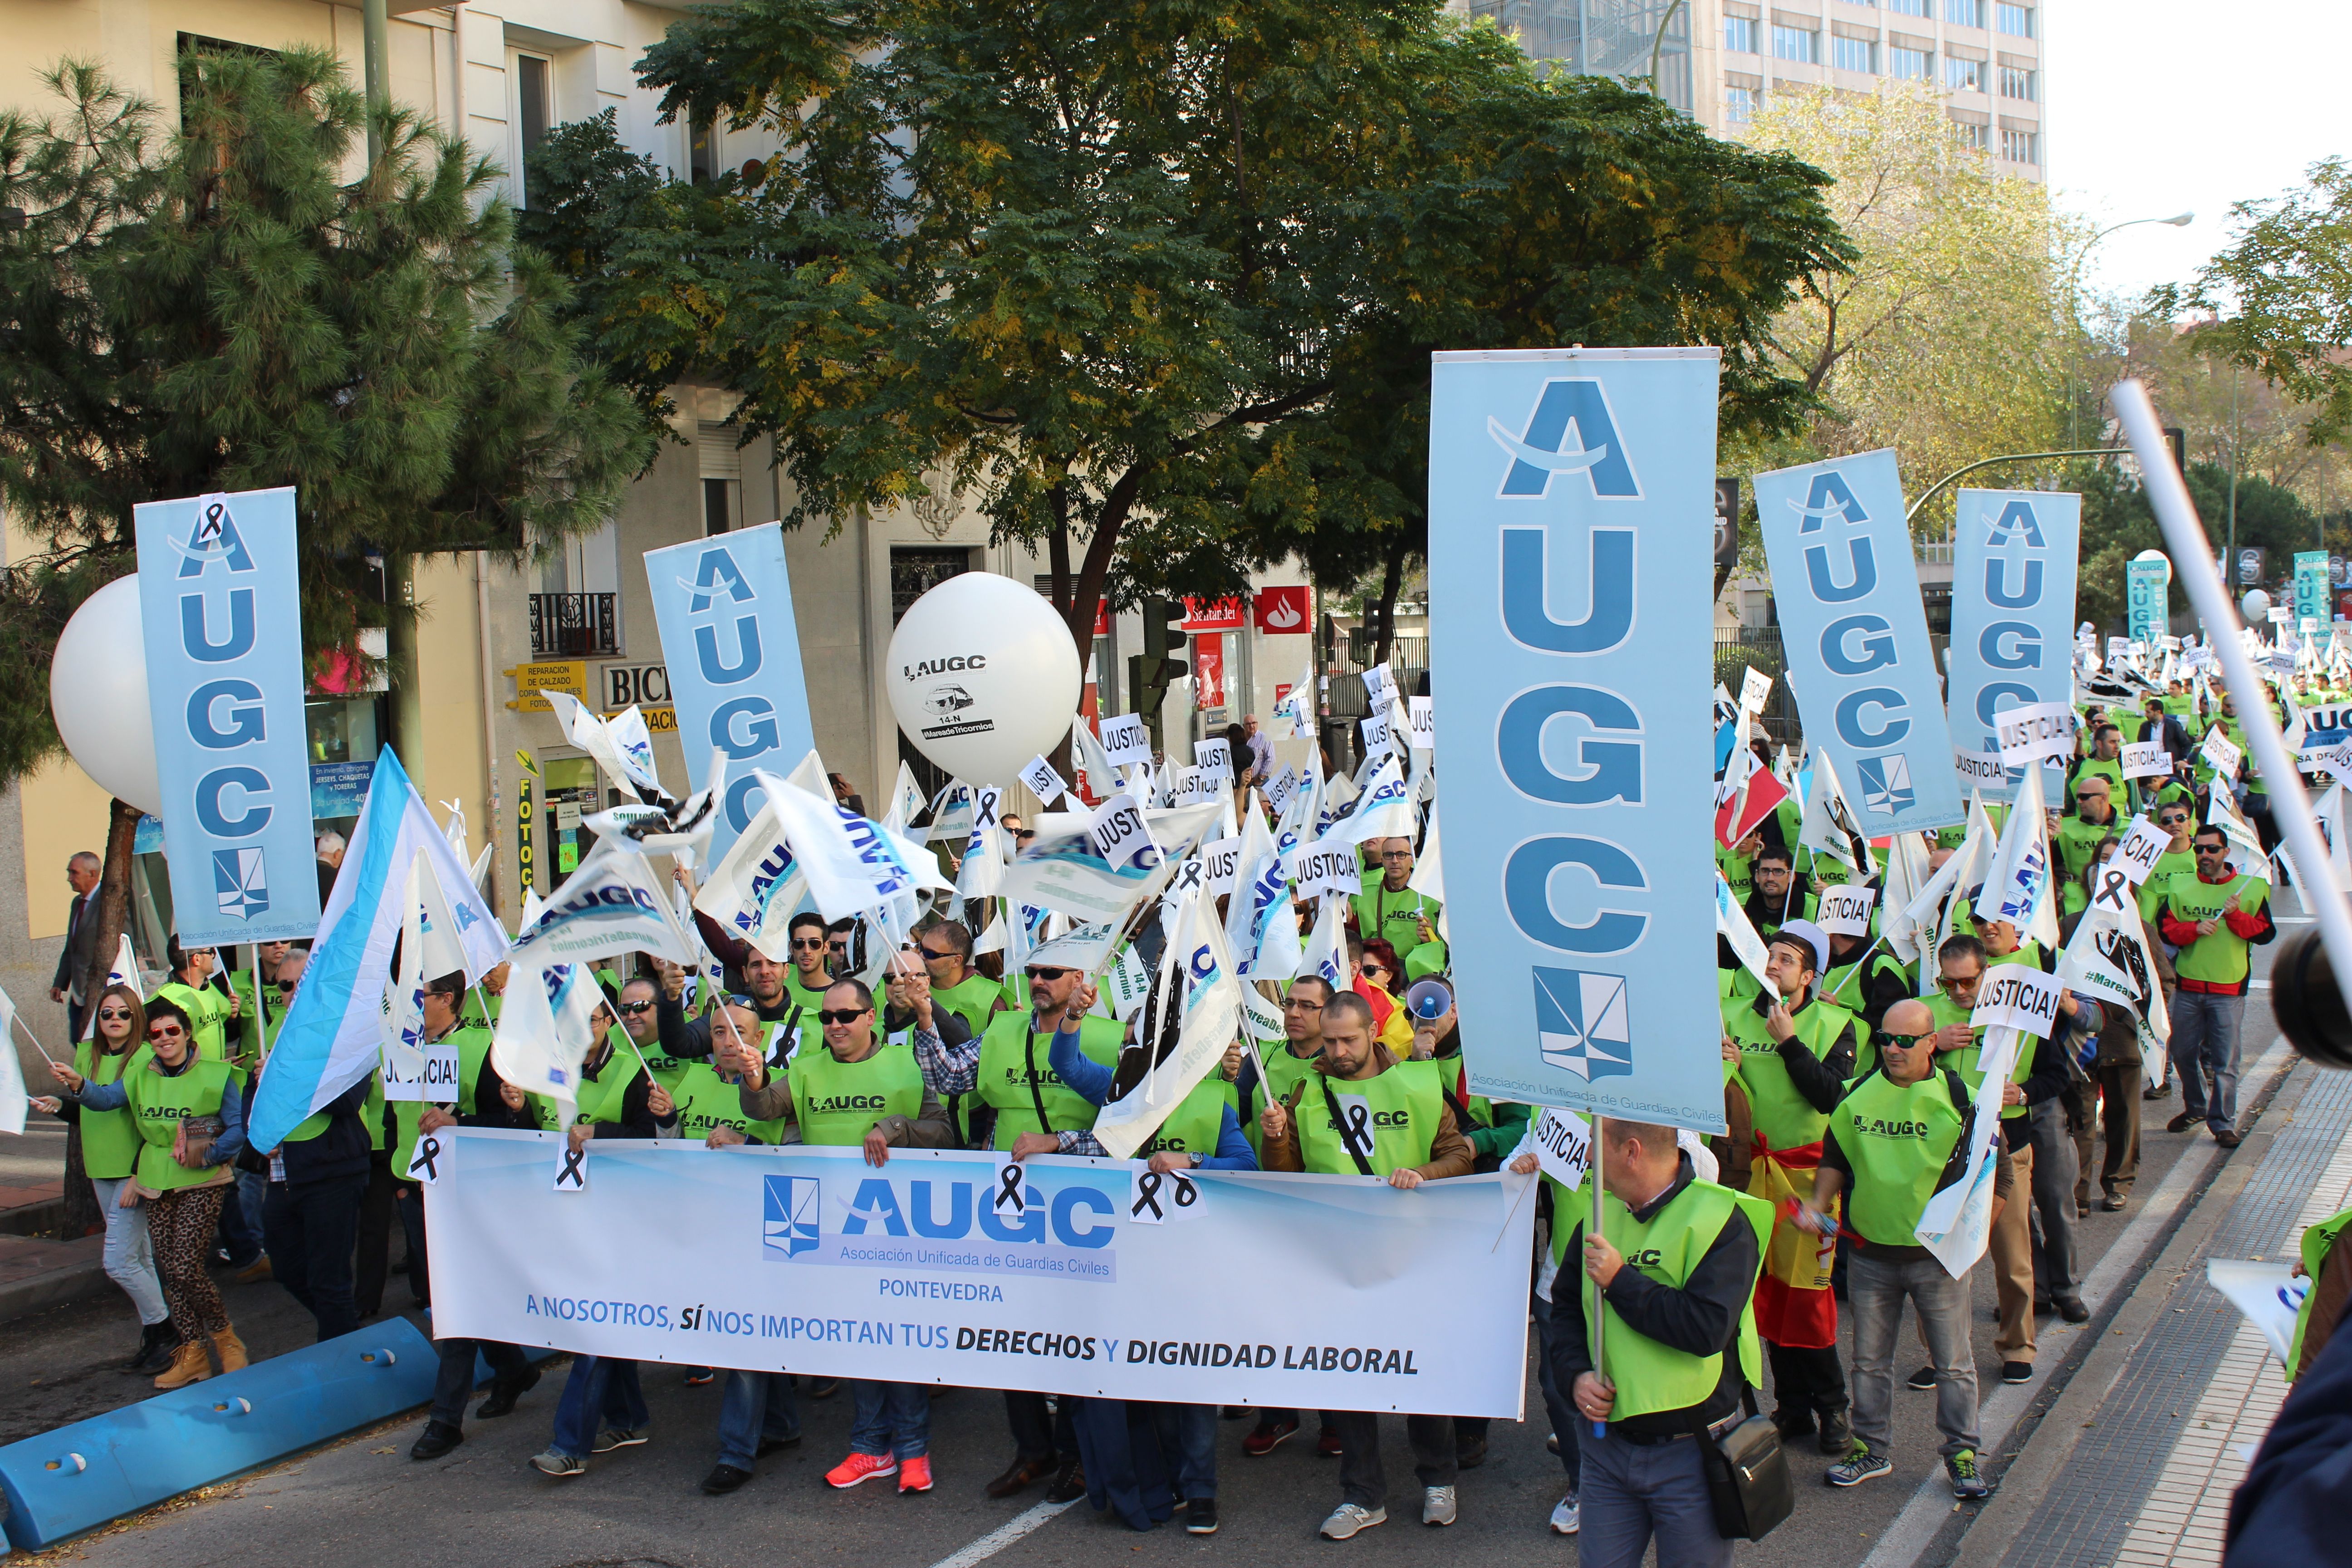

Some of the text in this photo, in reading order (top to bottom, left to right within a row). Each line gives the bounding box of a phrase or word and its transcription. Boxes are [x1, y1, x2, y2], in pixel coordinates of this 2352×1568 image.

[1787, 470, 1912, 750] AUGC
[1976, 500, 2048, 731] AUGC
[167, 507, 274, 839] AUGC
[528, 666, 570, 676] REPARACION
[915, 654, 987, 677] AUGC
[1488, 377, 1651, 957] AUGC
[519, 688, 541, 697] COPIAS
[539, 676, 571, 686] CALZADO
[923, 722, 994, 739] #MareadeTricornios
[939, 715, 961, 724] 14-N
[2001, 715, 2073, 750] JUSTICIA!
[2122, 750, 2159, 770] JUSTICIA!
[2206, 733, 2239, 769] JUSTICIA!
[338, 773, 370, 781] CHAQUETAS
[346, 765, 369, 773] abrigate
[1955, 753, 2005, 779] JUSTICIA!
[334, 783, 357, 791] TORERAS
[1269, 767, 1297, 806] JUSTICIA!
[326, 796, 350, 806] unidad
[1869, 820, 1899, 833] Unificada
[1911, 815, 1942, 826] Guardias
[1942, 812, 1965, 822] Civiles
[752, 843, 794, 906] AU
[1297, 853, 1359, 884] JUSTICIA!
[1816, 897, 1872, 924] JUSTICIA!
[181, 930, 217, 940] Asociación
[219, 926, 252, 937] Unificada
[264, 923, 295, 933] Guardias
[297, 921, 320, 930] Civiles
[1134, 972, 1147, 993] 14-N
[1976, 979, 2058, 1020] JUSTICIA!
[386, 1058, 457, 1085] JICIA!
[820, 1095, 886, 1110] AUGC
[1471, 1073, 1724, 1124] Asociación Unificada de Guardias Civiles
[692, 1114, 747, 1131] AUGC
[1870, 1119, 1928, 1137] AUGC
[1536, 1107, 1589, 1173] JUSTICIA!
[836, 1178, 1116, 1249] AUGC
[840, 1246, 1109, 1276] Asociación Unificada de Guardias Civiles
[879, 1279, 1004, 1303] PONTEVEDRA
[526, 1293, 1419, 1376] A NOSOTROS, SÍ NOS IMPORTAN TUS DERECHOS Y DIGNIDAD LABORAL
